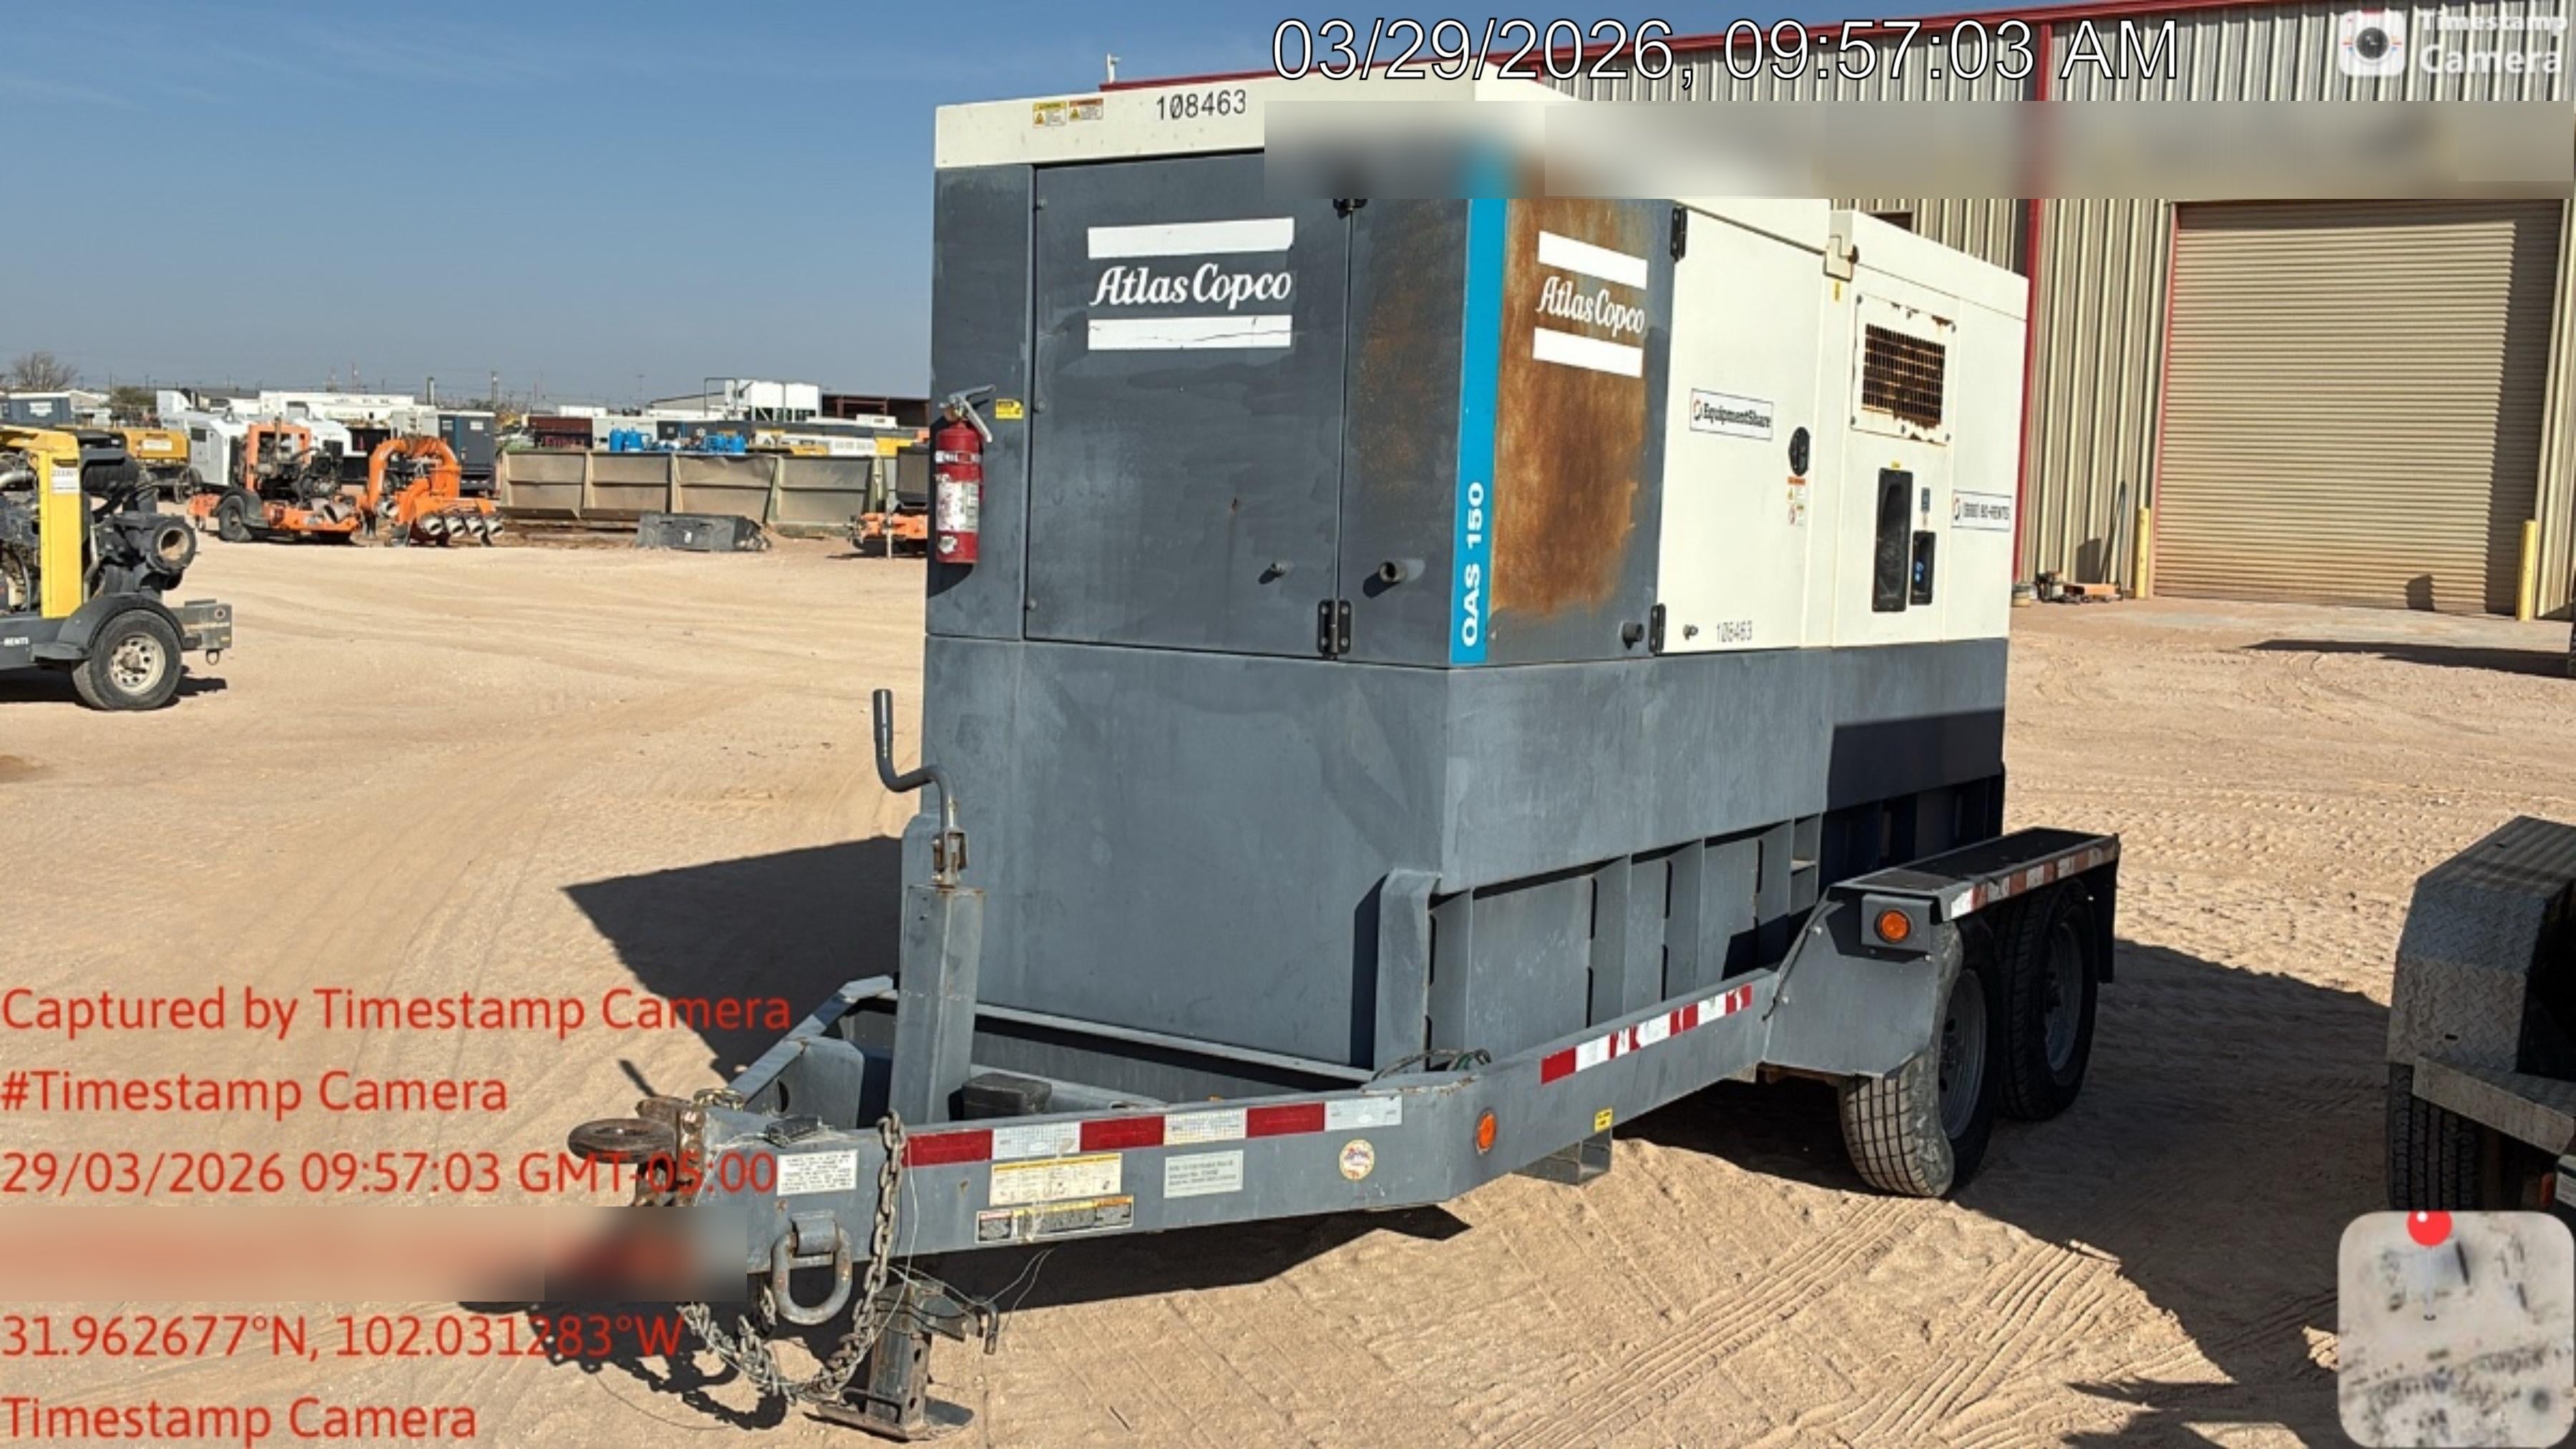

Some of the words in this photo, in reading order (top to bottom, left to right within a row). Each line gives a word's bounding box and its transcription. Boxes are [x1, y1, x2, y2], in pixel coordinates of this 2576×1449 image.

[1156, 89, 1246, 120] 108463
[1089, 265, 1189, 306] Atlas
[1193, 262, 1292, 311] Copco
[1535, 275, 1594, 323] Atlas
[1595, 288, 1645, 338] Copco
[1467, 482, 1483, 549] 150
[1462, 562, 1480, 647] QAS
